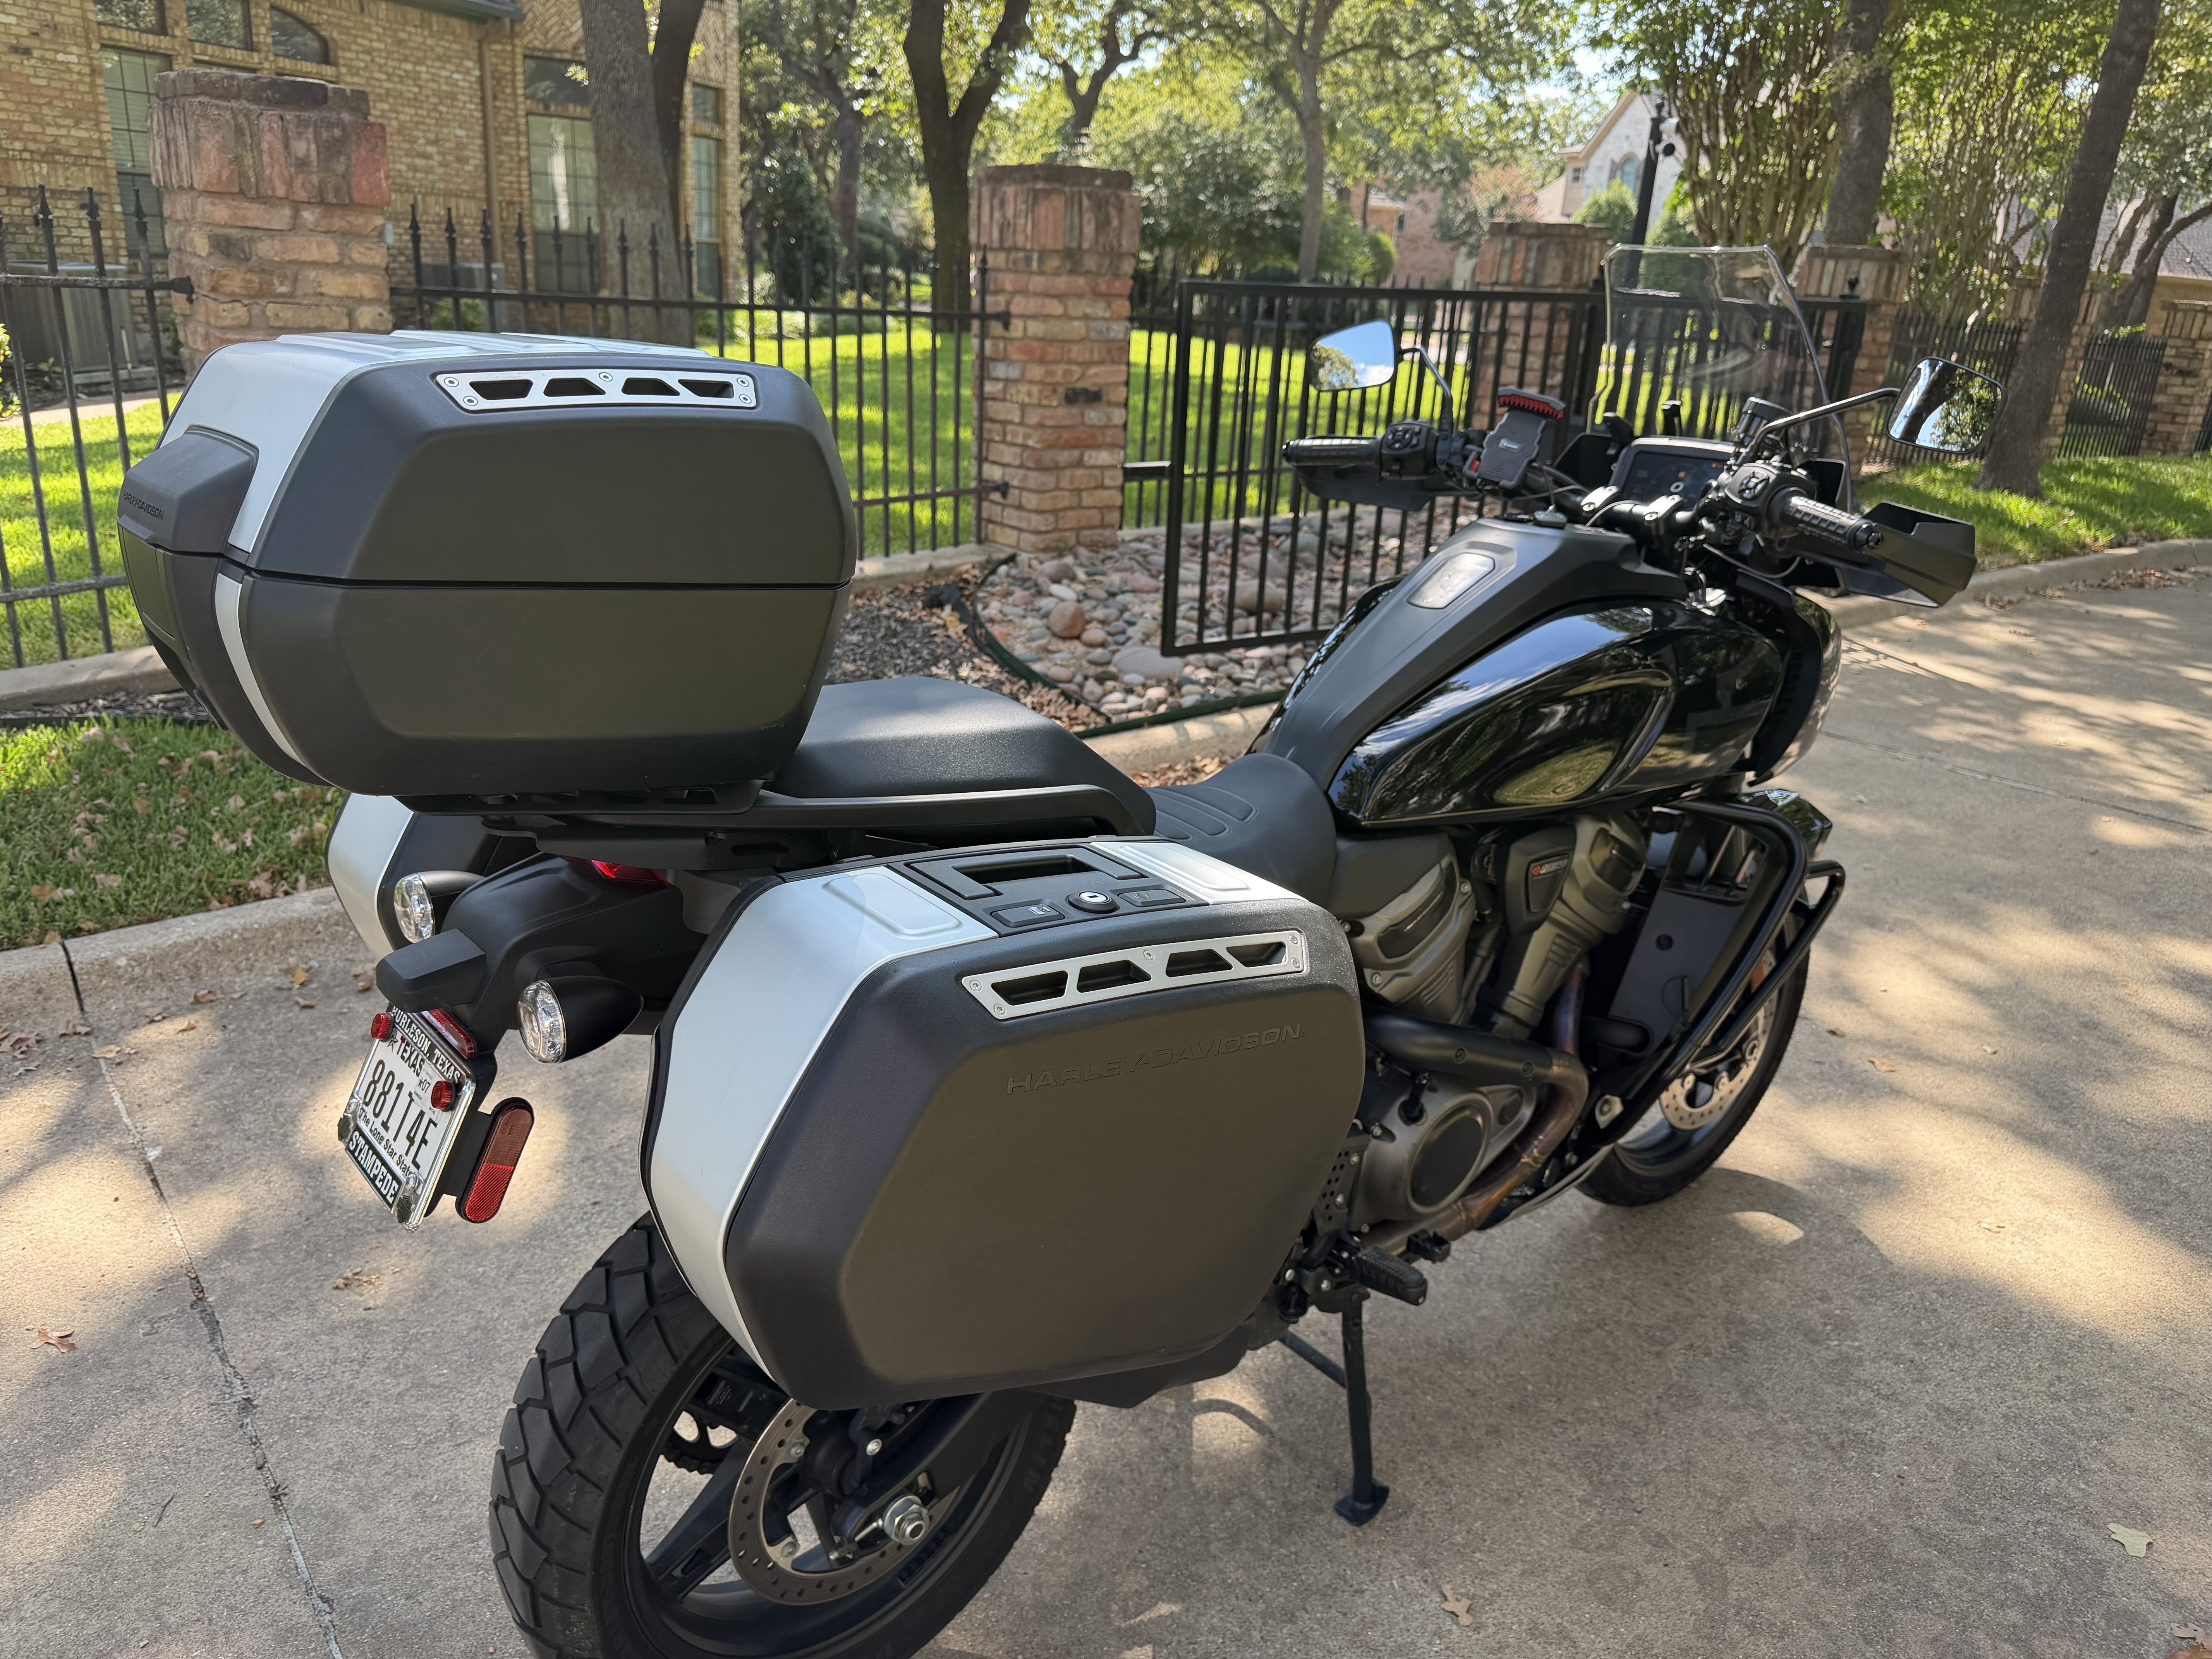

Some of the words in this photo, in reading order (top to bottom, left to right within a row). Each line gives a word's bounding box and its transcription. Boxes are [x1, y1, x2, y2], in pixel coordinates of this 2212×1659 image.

[397, 1034, 426, 1077] TEXAS
[432, 1048, 460, 1084] TEXAS
[1006, 1023, 1303, 1095] HARLEY-DAVIDSON
[359, 1107, 370, 1126] The
[370, 1120, 385, 1142] Lone
[384, 1139, 397, 1159] Star
[363, 1059, 438, 1171] 881T4E
[349, 1131, 398, 1204] STAMPEDE
